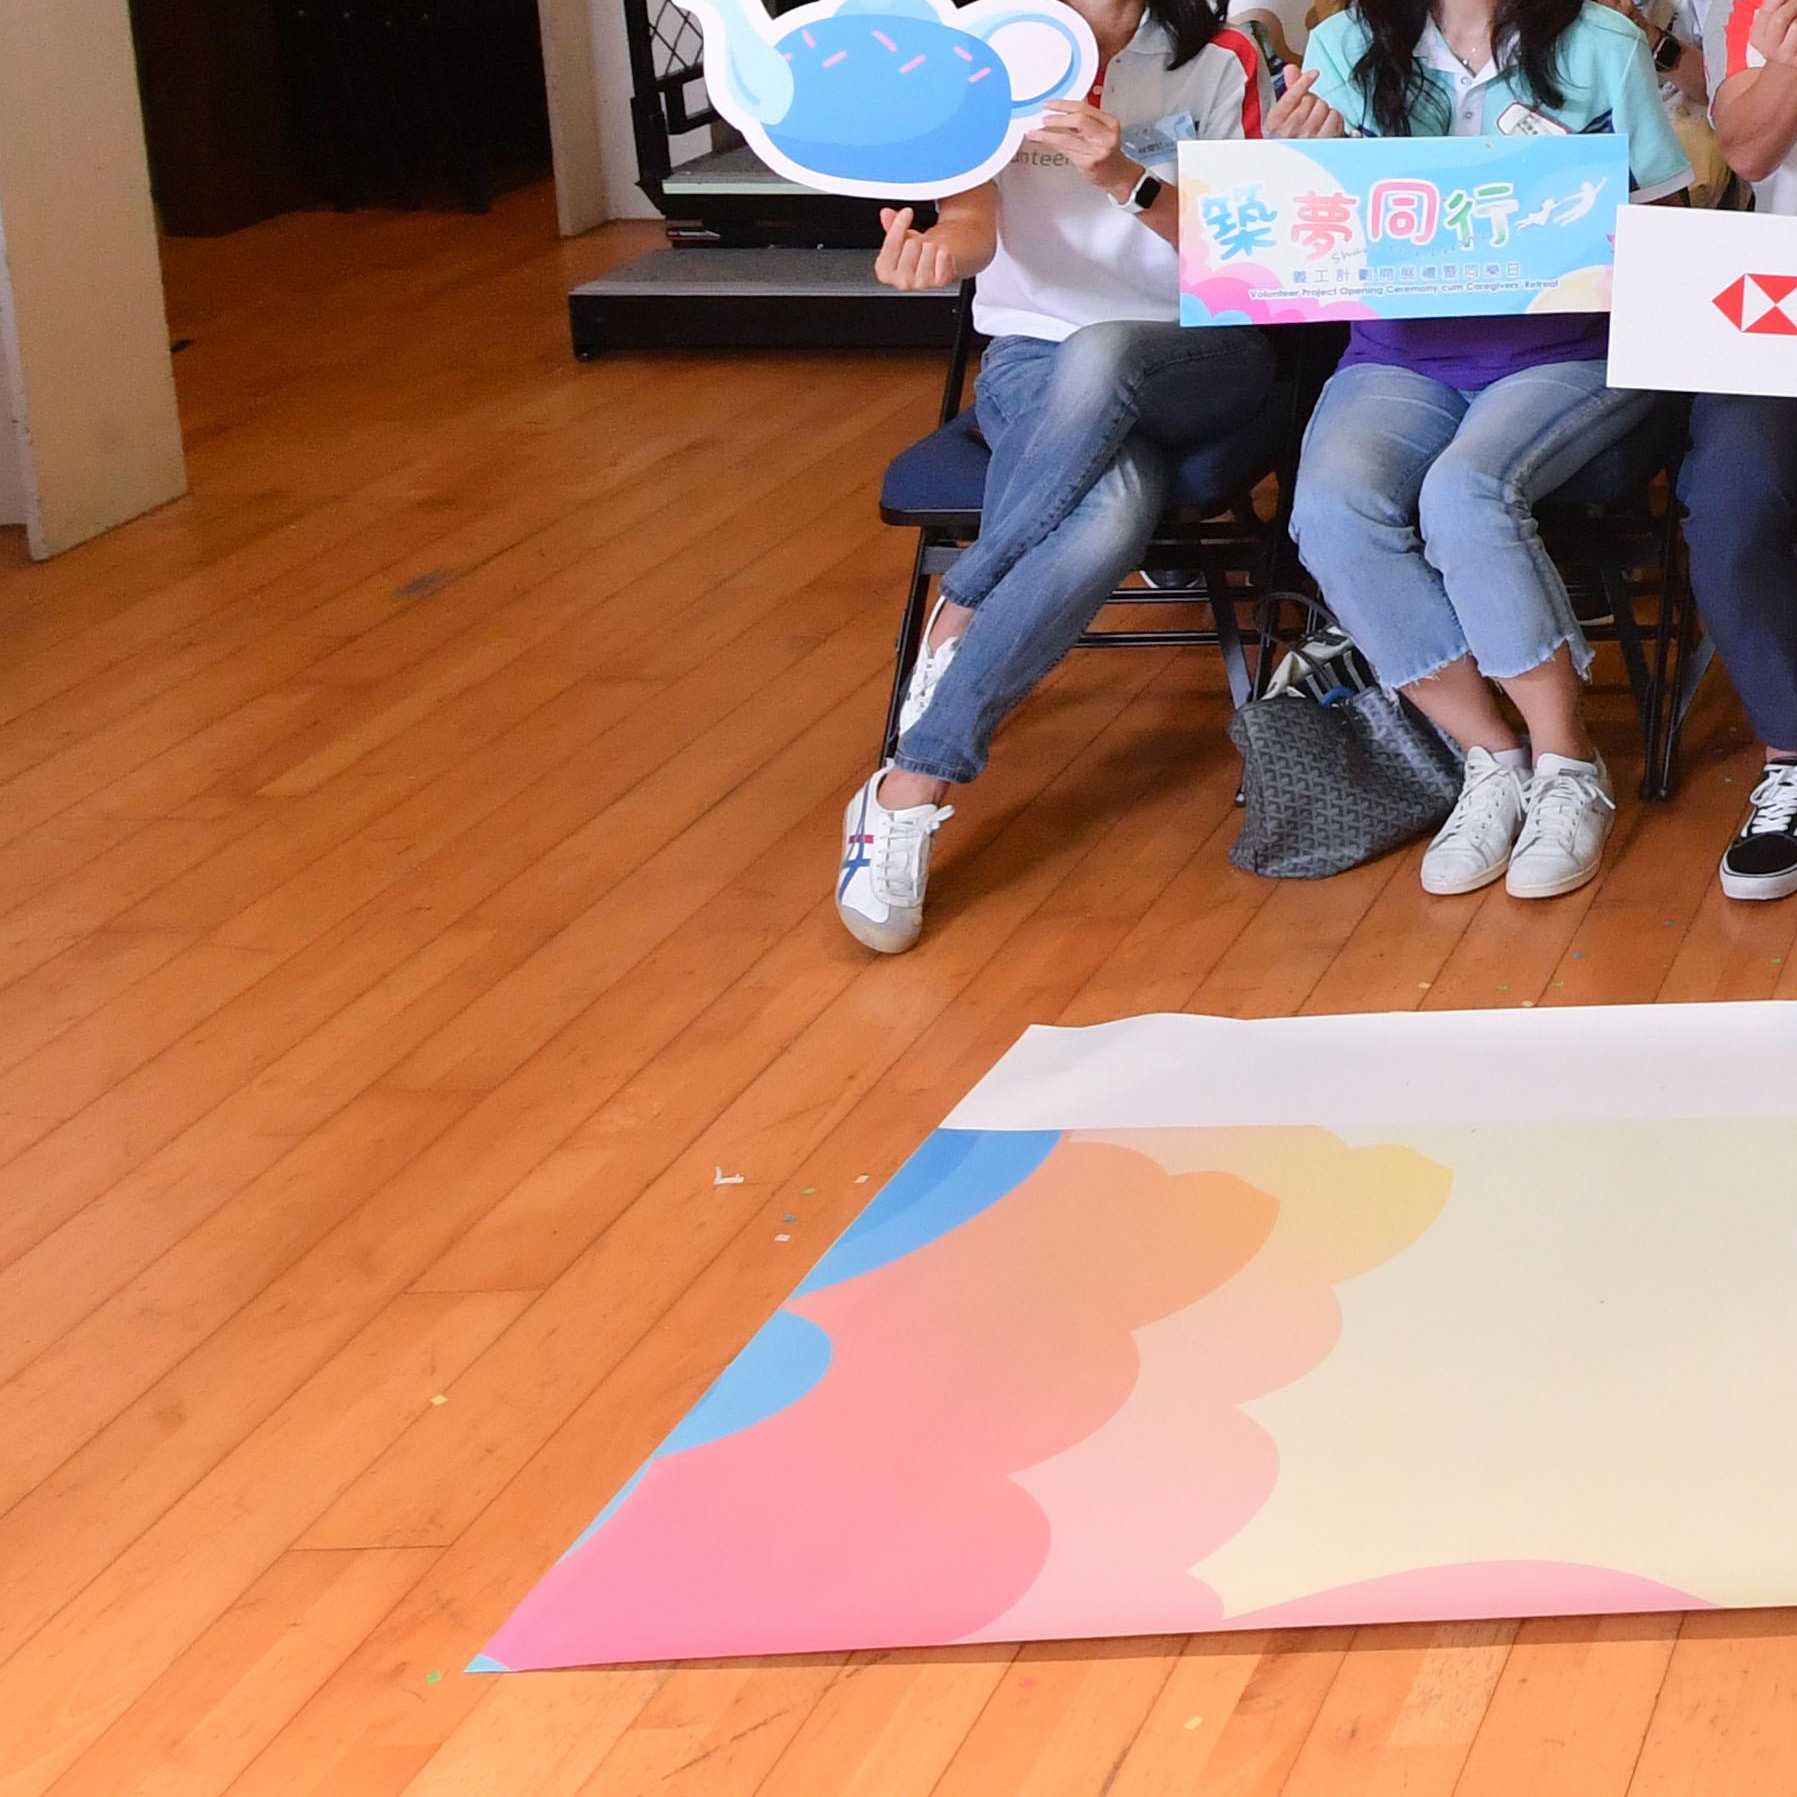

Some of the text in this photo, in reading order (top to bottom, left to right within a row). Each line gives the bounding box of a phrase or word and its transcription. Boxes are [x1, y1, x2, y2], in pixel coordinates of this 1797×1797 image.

[1202, 177, 1518, 261] 築夢同行
[1250, 286, 1299, 299] Volunteer
[1302, 284, 1337, 298] Project
[1340, 284, 1384, 297] Opening
[1386, 282, 1438, 295] Ceremony
[1442, 283, 1465, 291] cum
